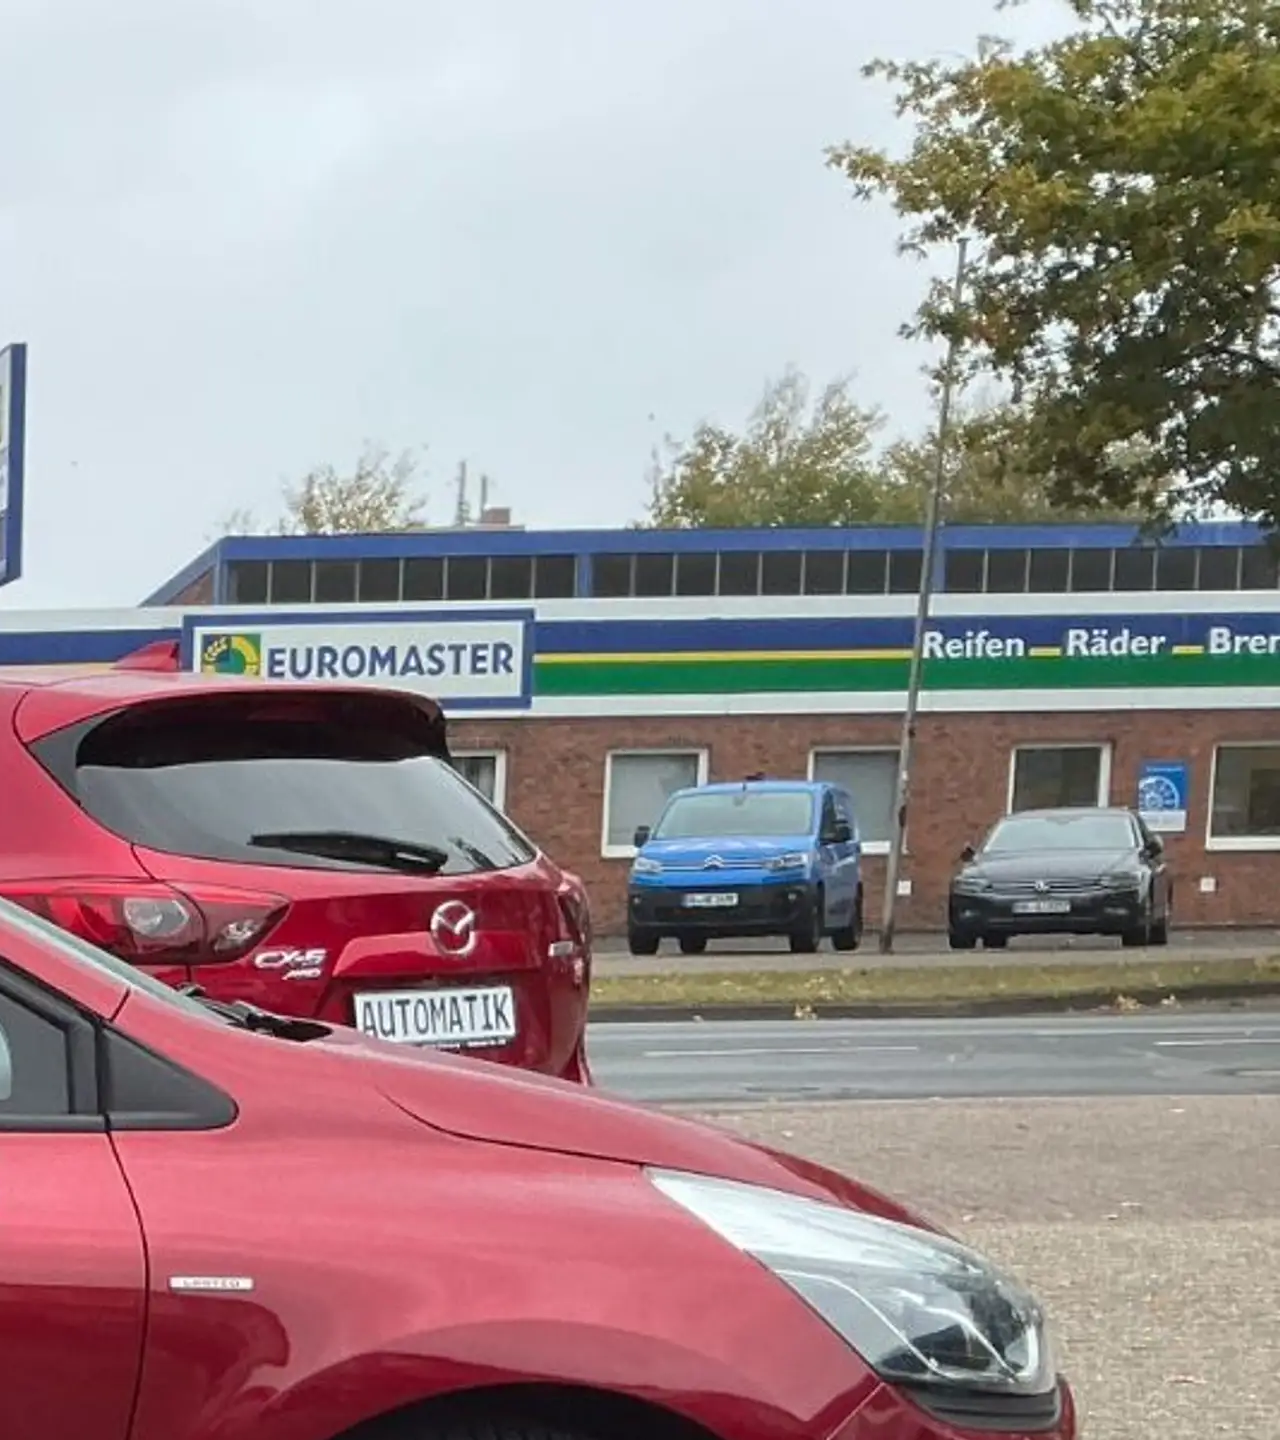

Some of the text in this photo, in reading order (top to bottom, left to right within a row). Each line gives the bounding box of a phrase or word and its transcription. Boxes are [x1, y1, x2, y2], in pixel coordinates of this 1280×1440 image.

[267, 641, 513, 679] EUROMASTER
[921, 630, 1024, 659] Reifen
[1066, 628, 1166, 657] Räder
[254, 949, 326, 969] CX-5
[362, 992, 512, 1038] AUTOMATIK
